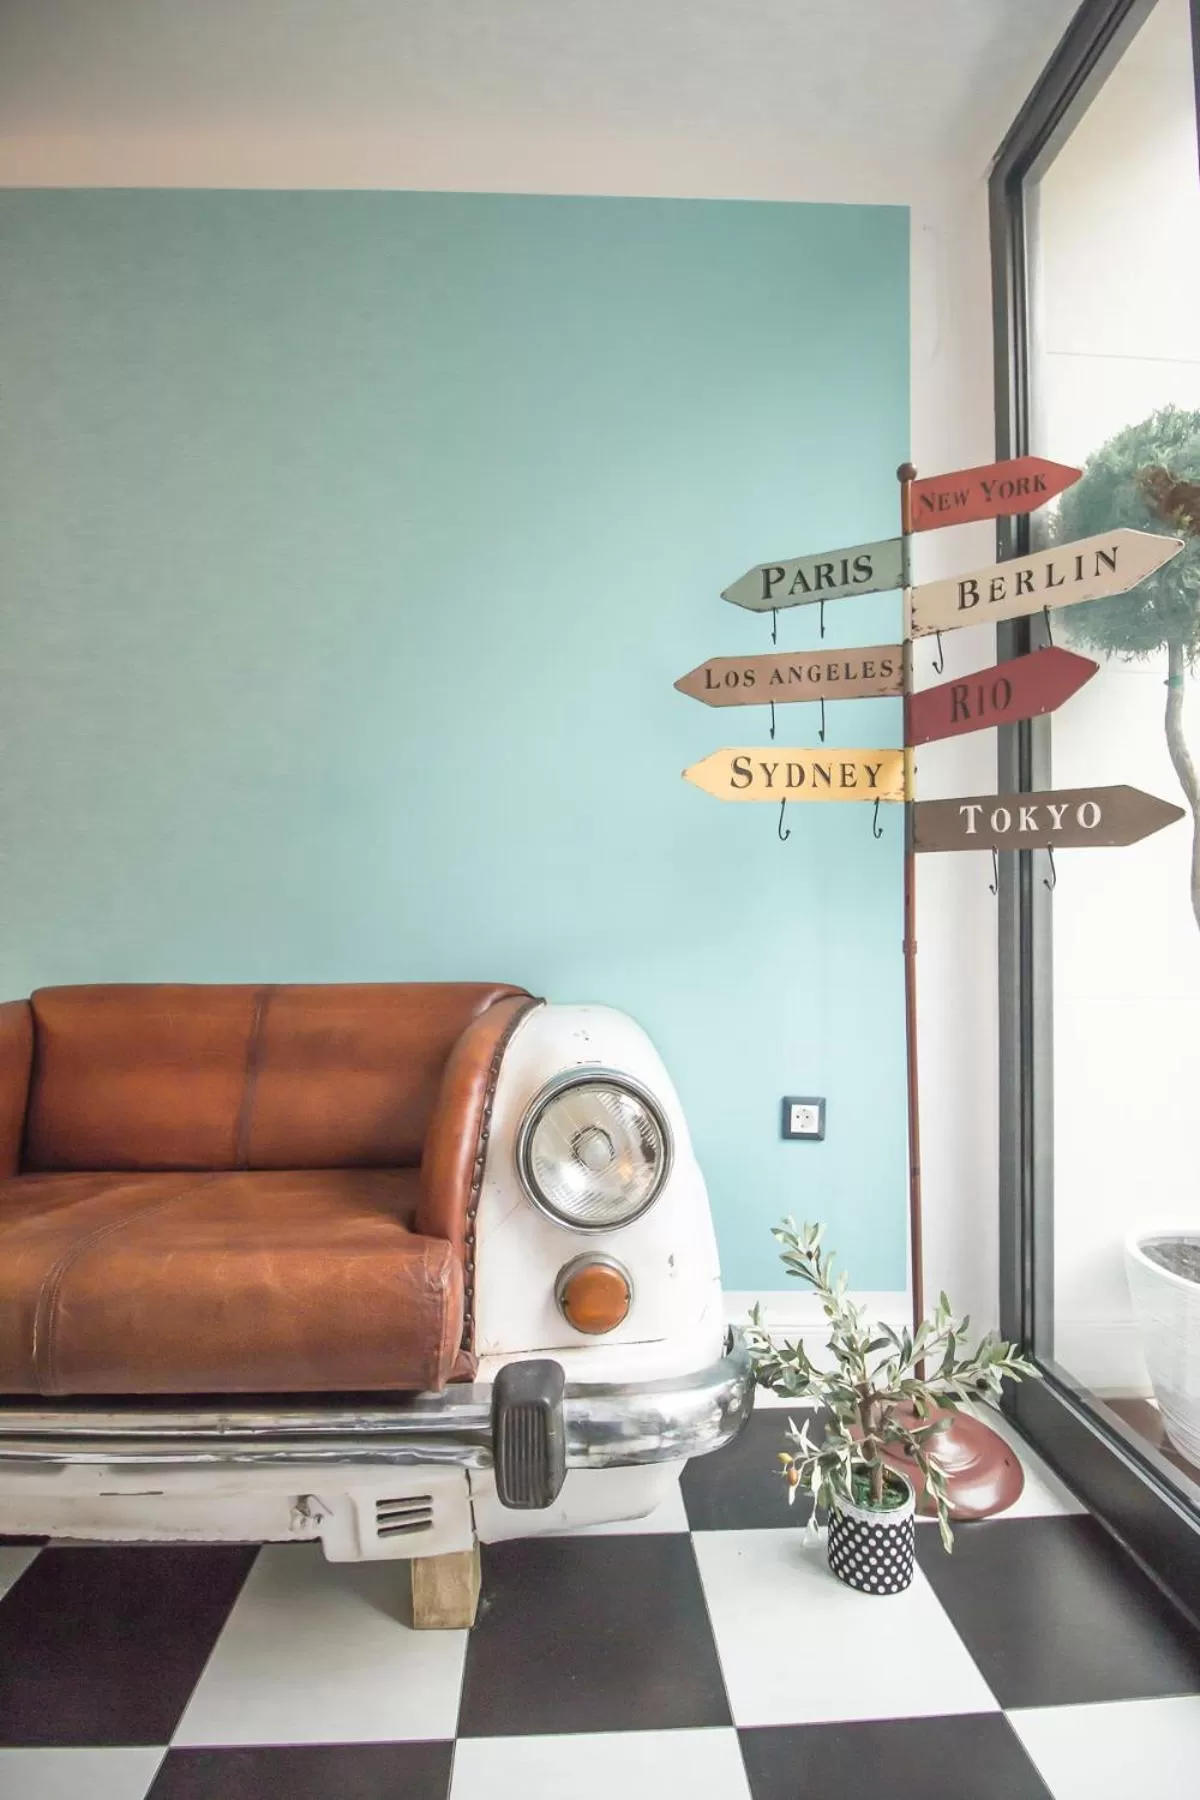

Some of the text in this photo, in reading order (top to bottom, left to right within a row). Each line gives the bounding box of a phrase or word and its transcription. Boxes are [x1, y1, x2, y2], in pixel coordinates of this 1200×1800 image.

[920, 474, 1047, 513] NEW YORK
[761, 555, 873, 600] PARIS
[958, 547, 1119, 610] BERLIN
[705, 659, 893, 690] LOS ANGELES
[951, 678, 1012, 722] RIO
[730, 756, 883, 788] SYDNEY
[959, 802, 1102, 834] TOKYO
